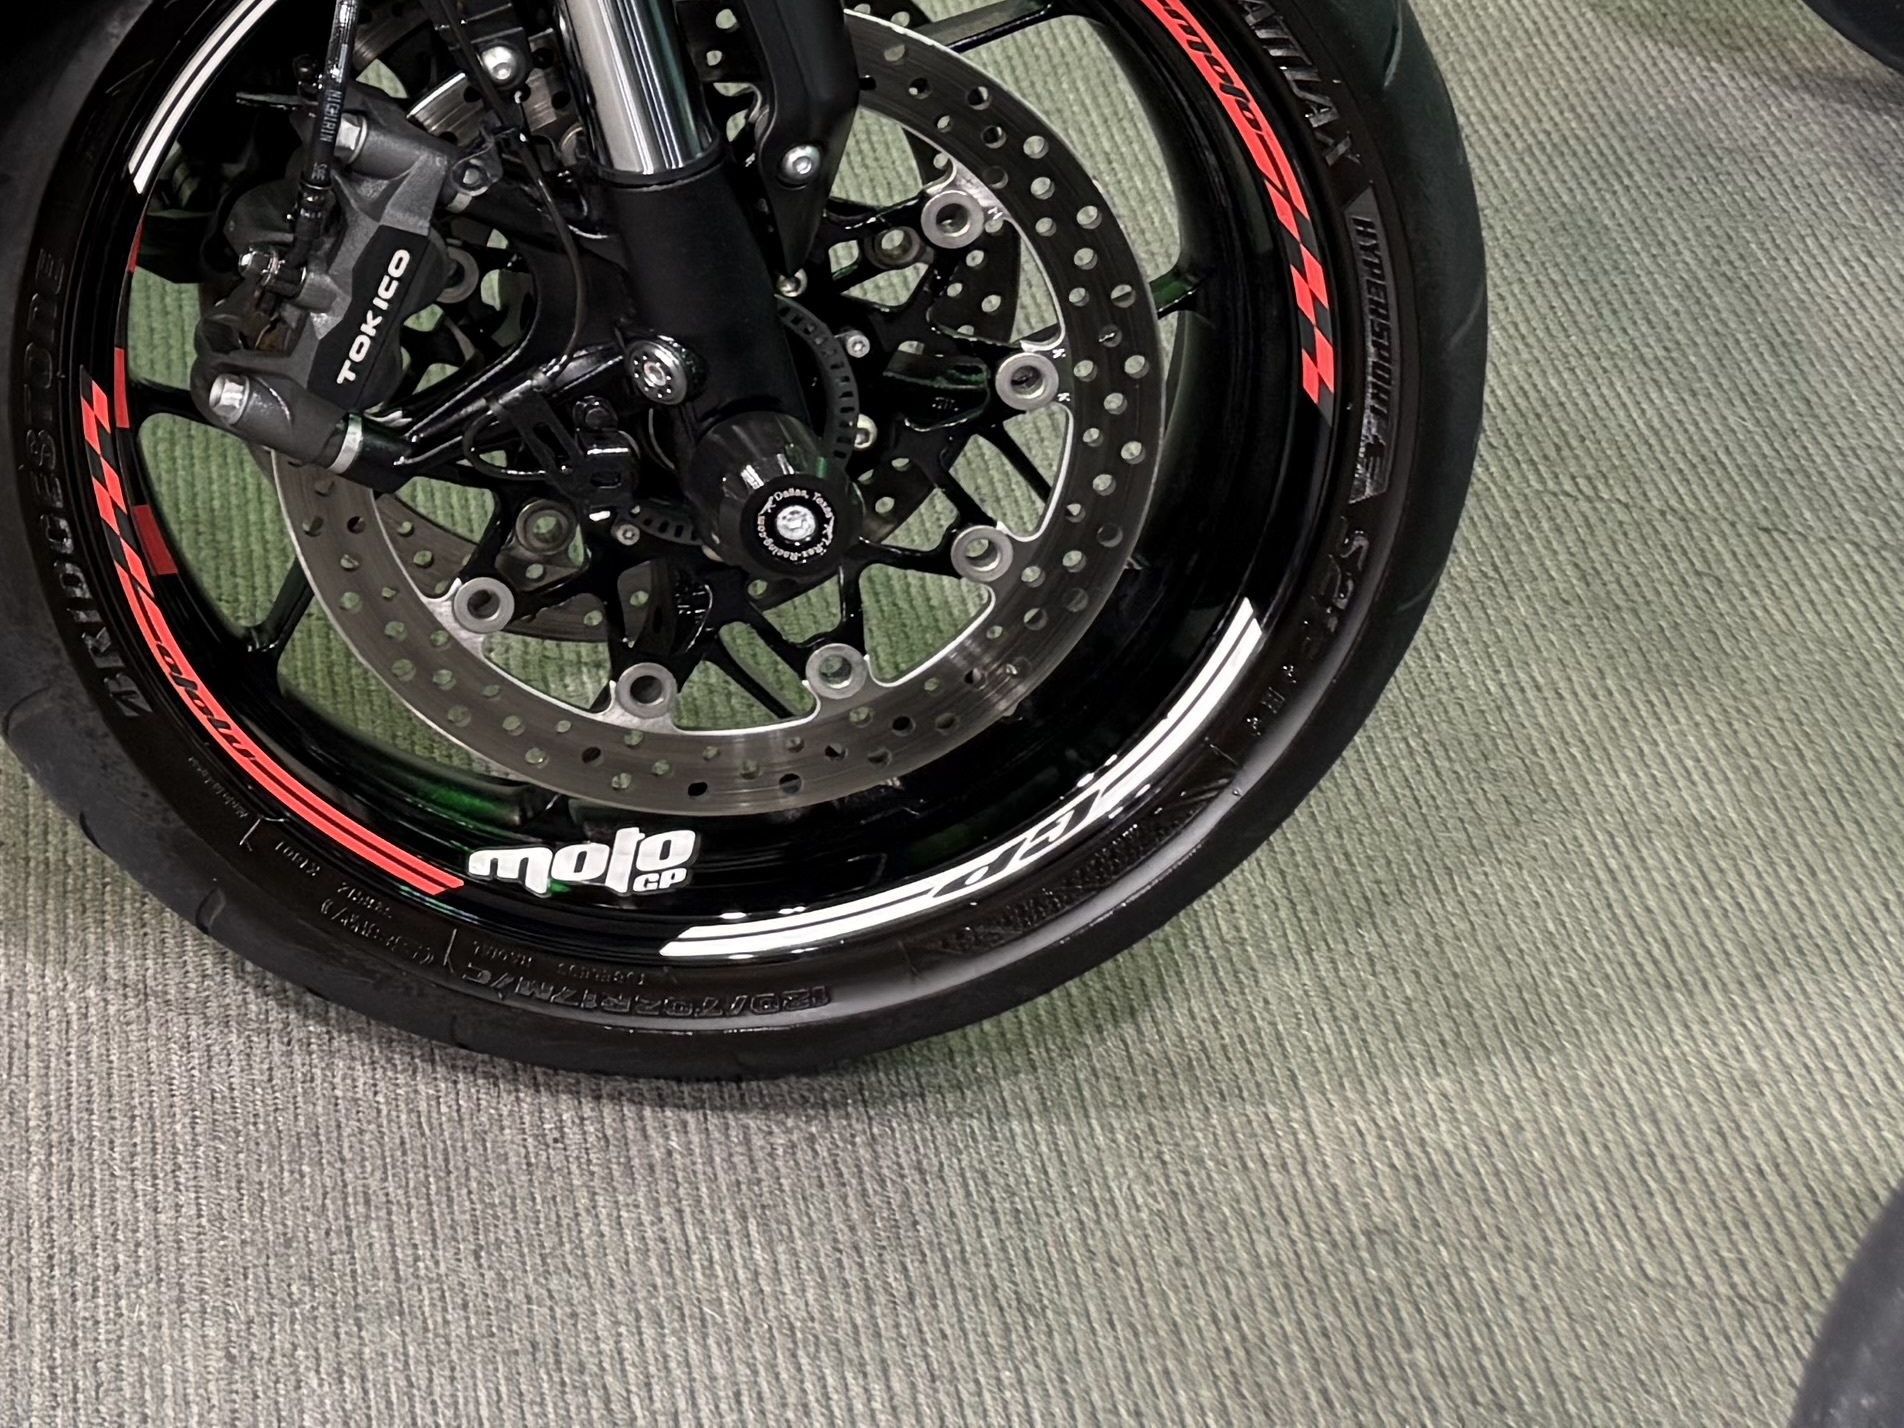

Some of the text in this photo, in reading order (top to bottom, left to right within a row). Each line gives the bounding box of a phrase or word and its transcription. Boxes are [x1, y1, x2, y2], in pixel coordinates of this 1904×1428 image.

[335, 248, 411, 385] TOKICO
[24, 248, 155, 718] BRIDGESTONE
[467, 826, 698, 896] moto
[632, 866, 688, 893] GP
